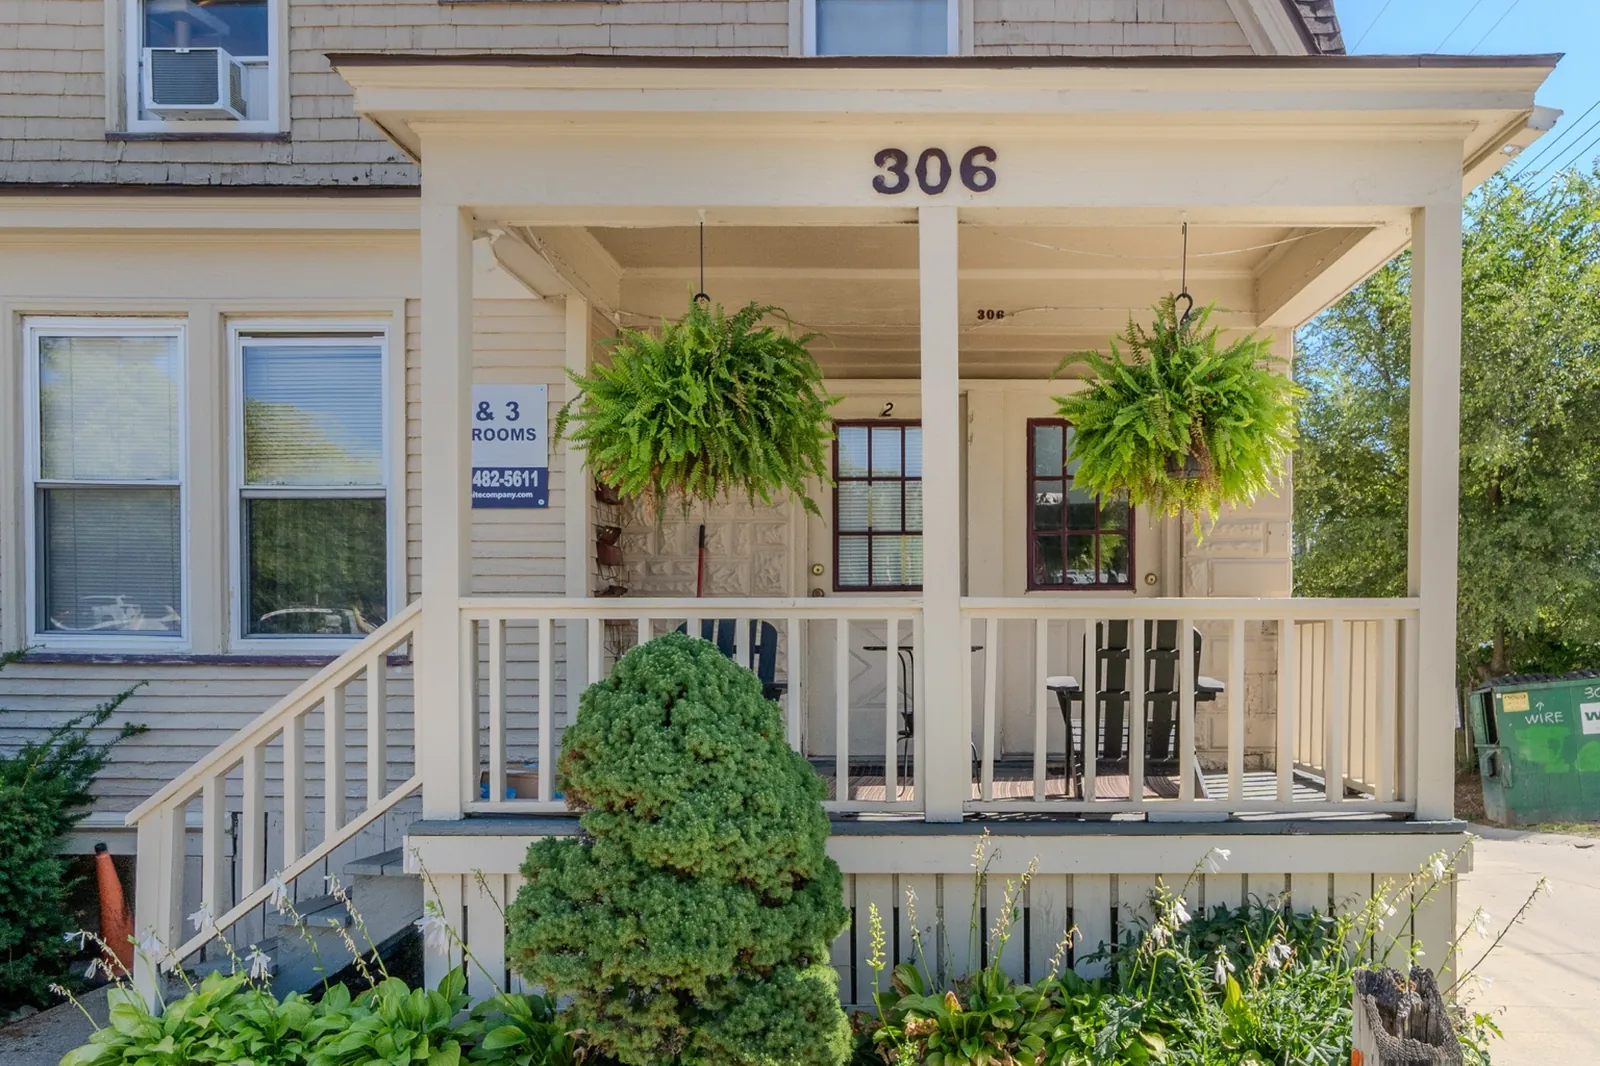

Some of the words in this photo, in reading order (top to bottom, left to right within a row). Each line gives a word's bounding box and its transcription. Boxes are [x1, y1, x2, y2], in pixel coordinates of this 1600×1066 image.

[872, 145, 997, 195] 306
[977, 309, 1005, 320] 306
[476, 401, 495, 421] &
[505, 401, 520, 421] 3
[881, 402, 894, 417] 2
[472, 428, 537, 441] ROOMS
[472, 470, 539, 488] 482-5611
[1524, 711, 1565, 724] WIRE
